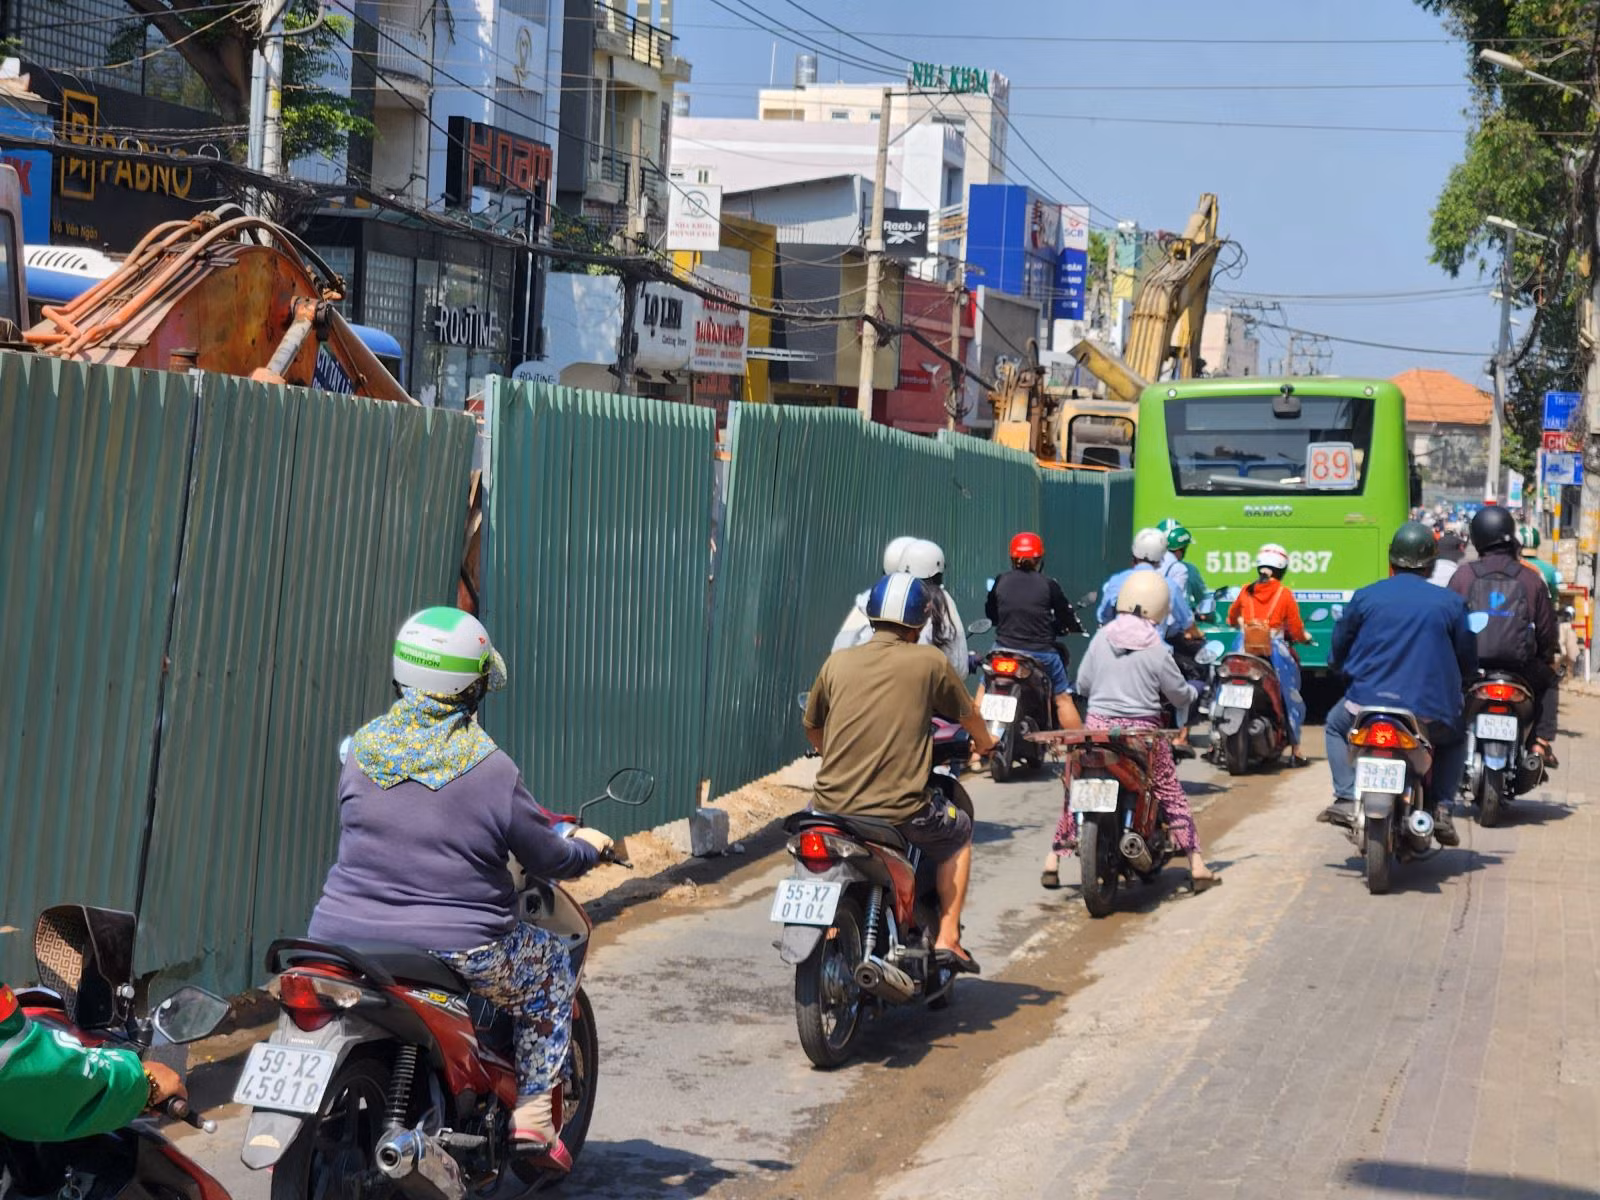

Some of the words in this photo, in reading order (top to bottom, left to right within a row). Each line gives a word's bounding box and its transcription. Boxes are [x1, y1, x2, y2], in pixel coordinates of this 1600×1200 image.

[949, 65, 989, 94] KHOA
[434, 302, 501, 349] ROUTINE
[1312, 450, 1350, 480] 89
[399, 650, 441, 668] NUTRITION
[786, 884, 831, 902] 55-X7
[782, 902, 825, 920] 0104
[259, 1049, 322, 1079] 59-X2
